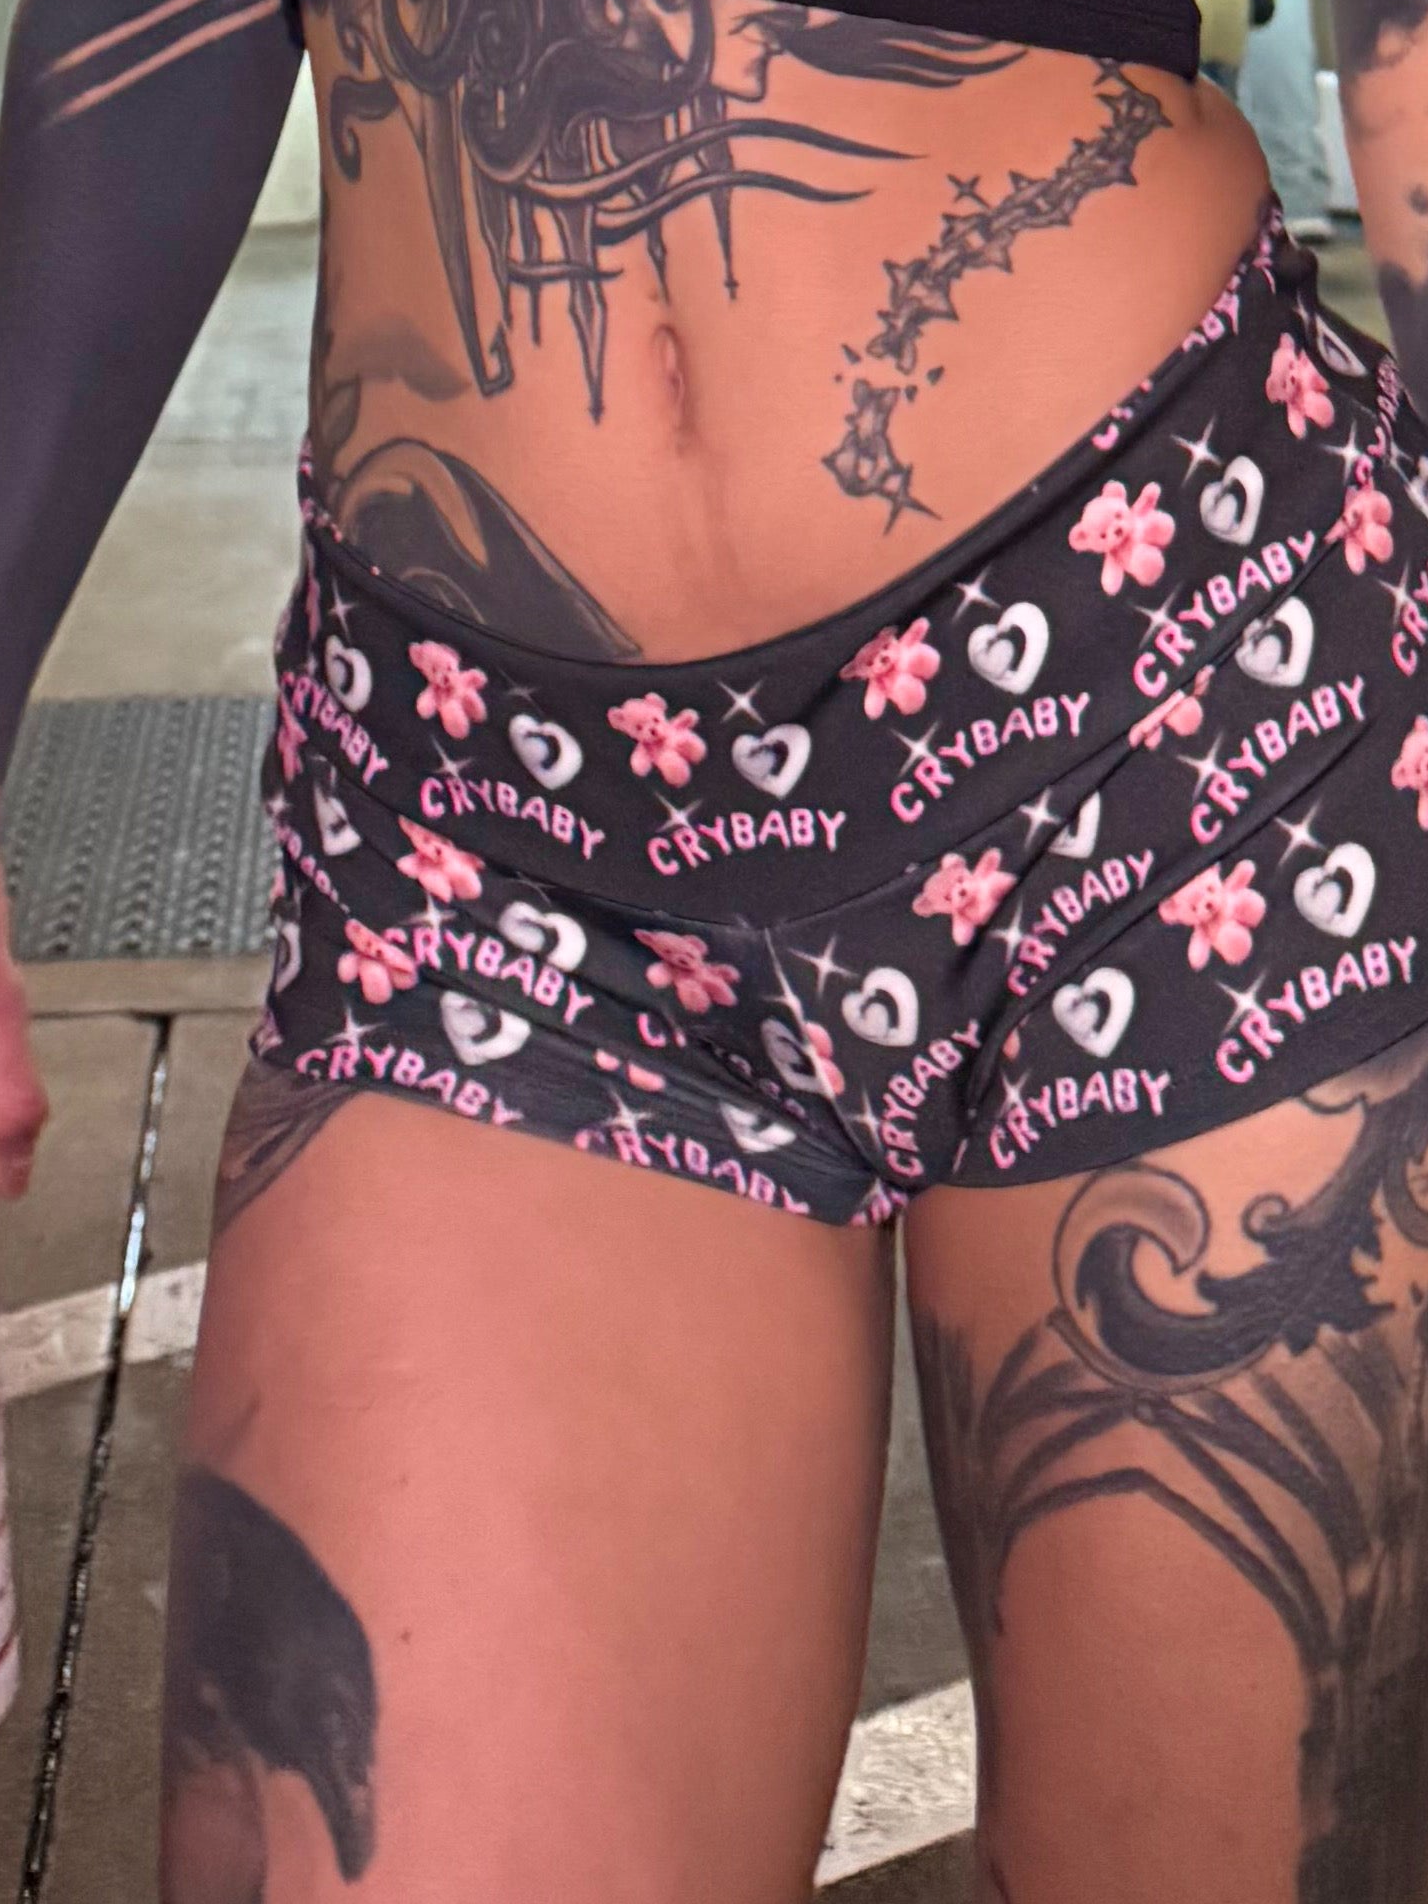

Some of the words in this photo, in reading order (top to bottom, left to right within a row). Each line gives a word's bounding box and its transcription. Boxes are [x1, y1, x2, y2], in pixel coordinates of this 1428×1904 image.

[1133, 530, 1315, 698] CRYBABY
[420, 777, 606, 861] CRYBABY
[890, 692, 1090, 823] CRYBABY
[1190, 674, 1364, 844] CRYBABY
[647, 808, 847, 876] CRYBABY
[1007, 848, 1154, 996] CRYBABY
[1215, 936, 1417, 1084] CRYBABY
[880, 1018, 981, 1177] CRYBABY
[990, 1068, 1170, 1169] CRYBABY
